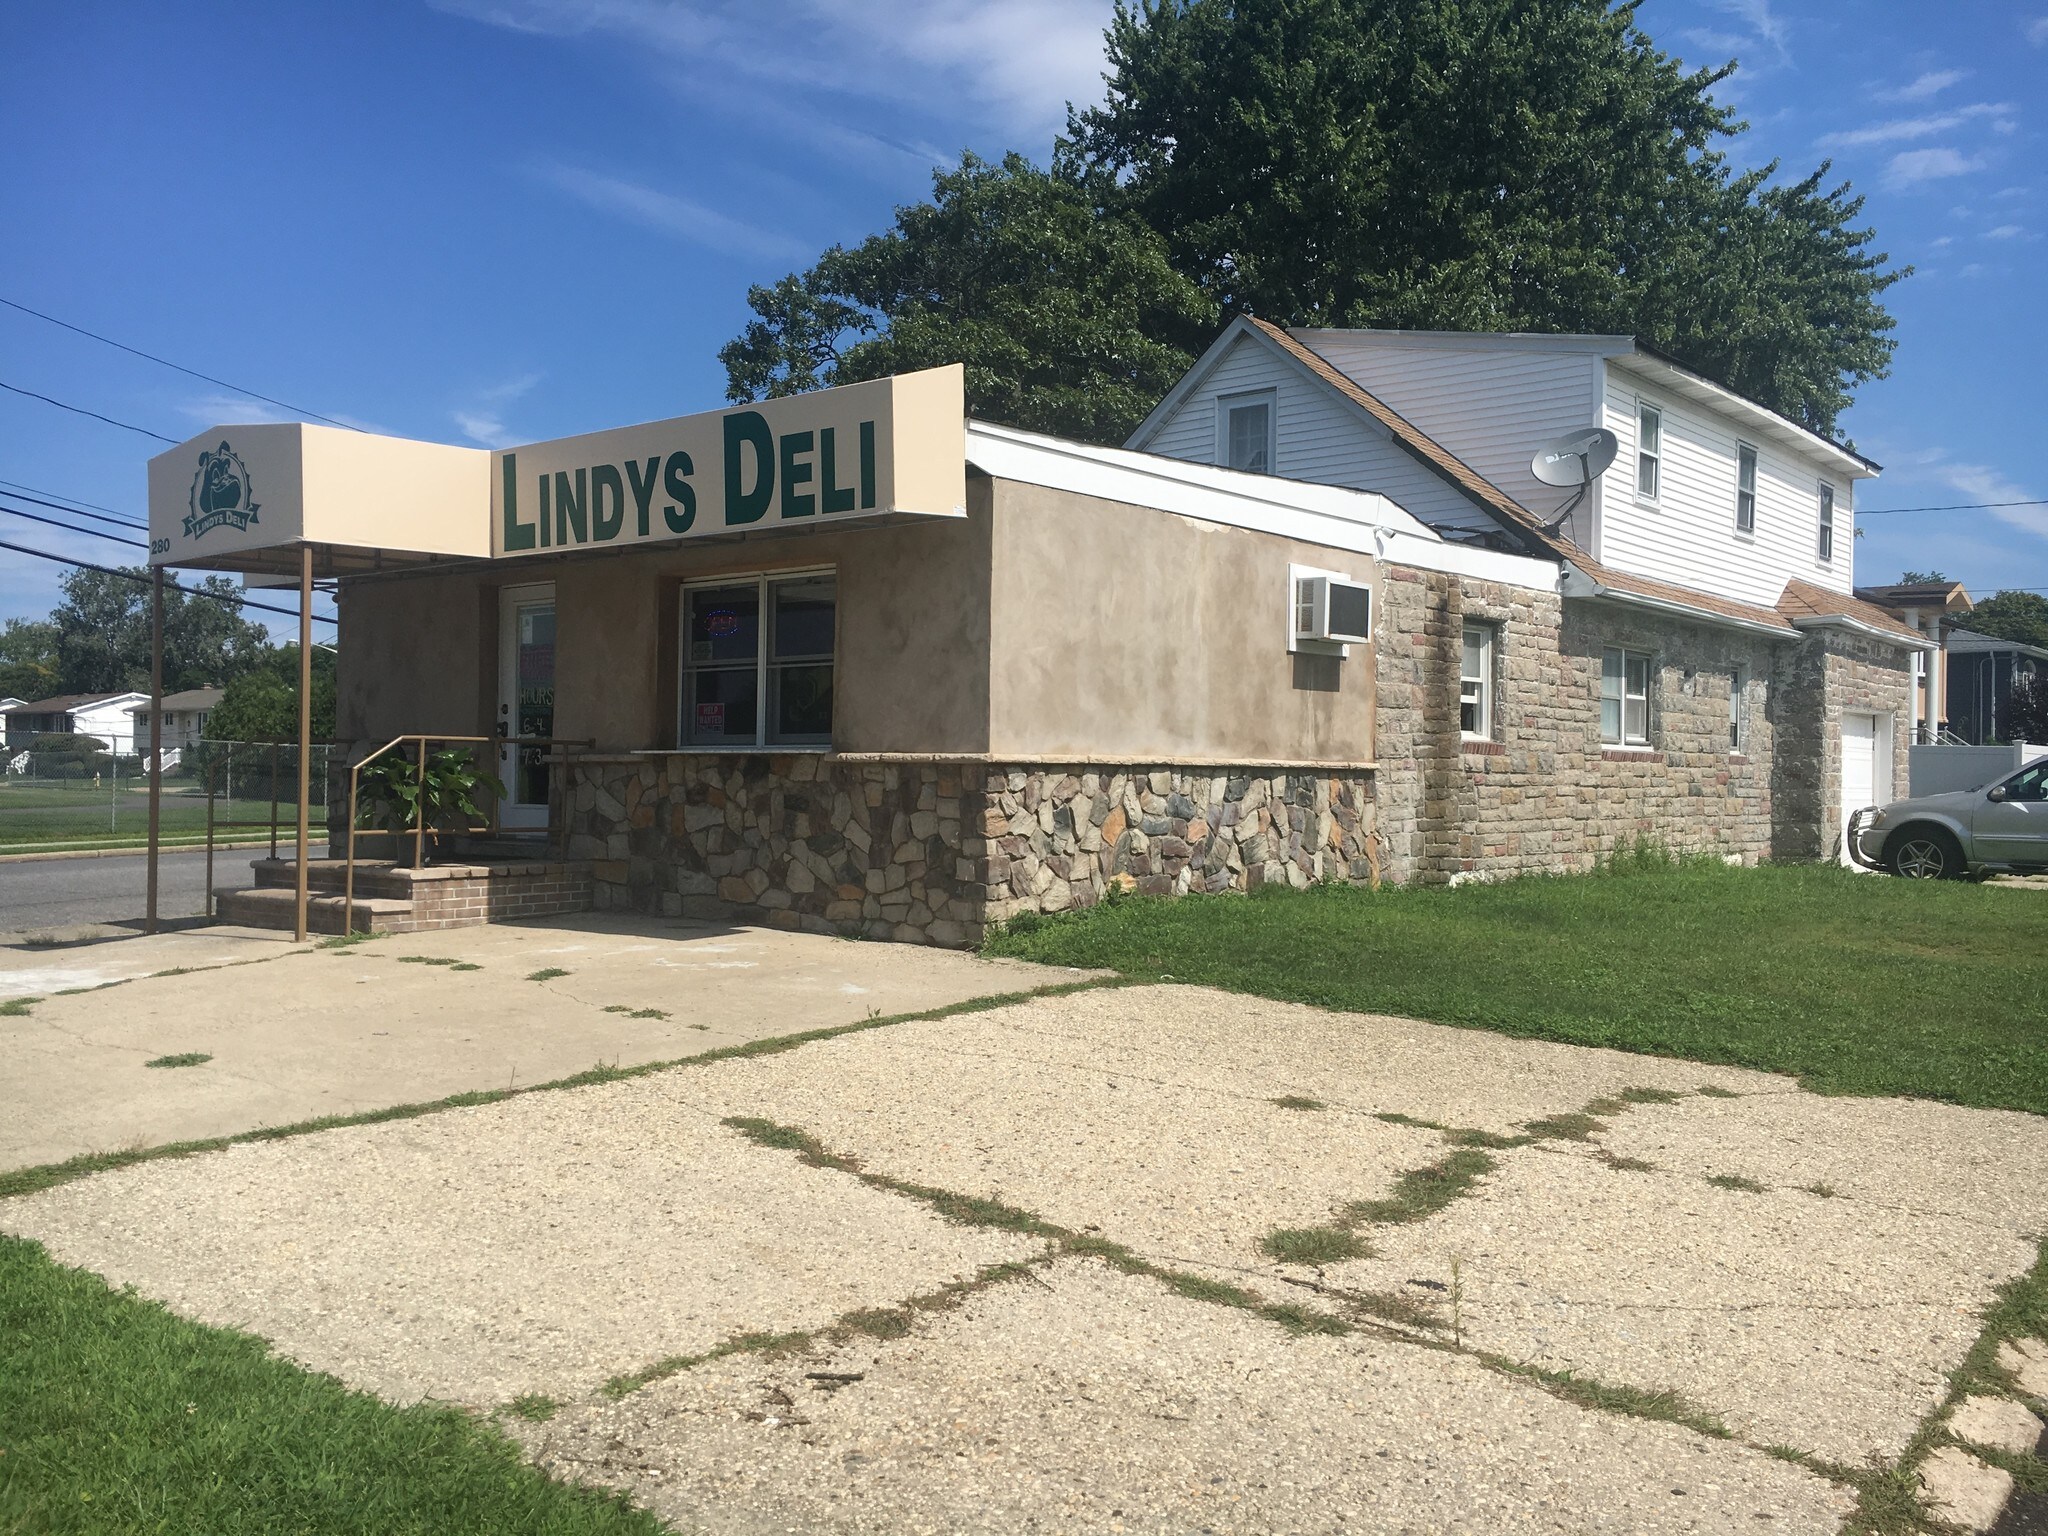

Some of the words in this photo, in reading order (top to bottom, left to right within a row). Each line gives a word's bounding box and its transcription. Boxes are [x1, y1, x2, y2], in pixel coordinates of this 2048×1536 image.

[503, 451, 697, 552] LINDYS
[723, 411, 876, 526] DELI
[195, 515, 224, 535] LINDYS
[226, 511, 245, 528] DELI
[151, 538, 170, 554] 280
[520, 688, 553, 705] HOURS
[703, 705, 718, 715] HELP
[698, 715, 723, 725] WANTED
